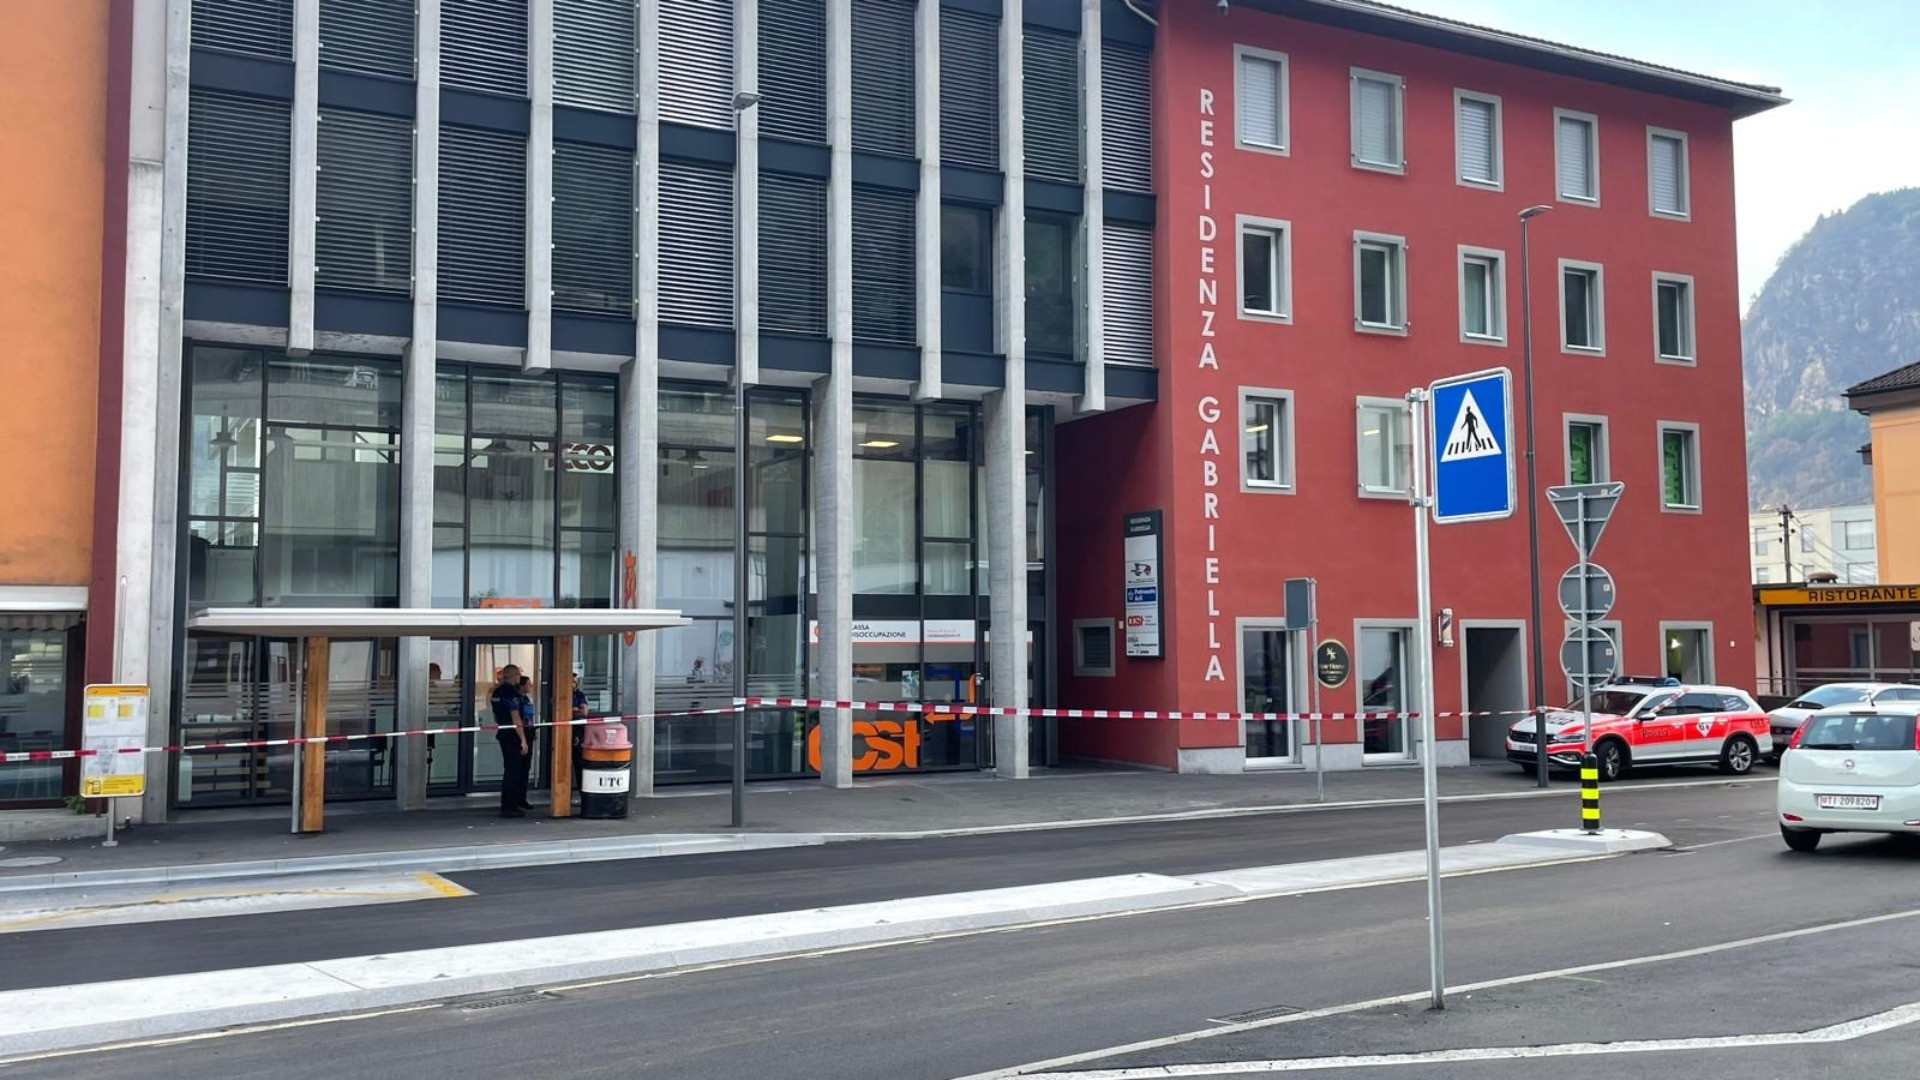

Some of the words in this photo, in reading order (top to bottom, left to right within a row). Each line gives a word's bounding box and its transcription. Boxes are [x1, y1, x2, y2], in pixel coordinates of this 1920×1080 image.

[1199, 88, 1218, 370] RESIDENZA
[1199, 396, 1225, 681] GABRIELLA
[1808, 587, 1917, 602] RISTORANTE
[599, 777, 623, 787] UTC
